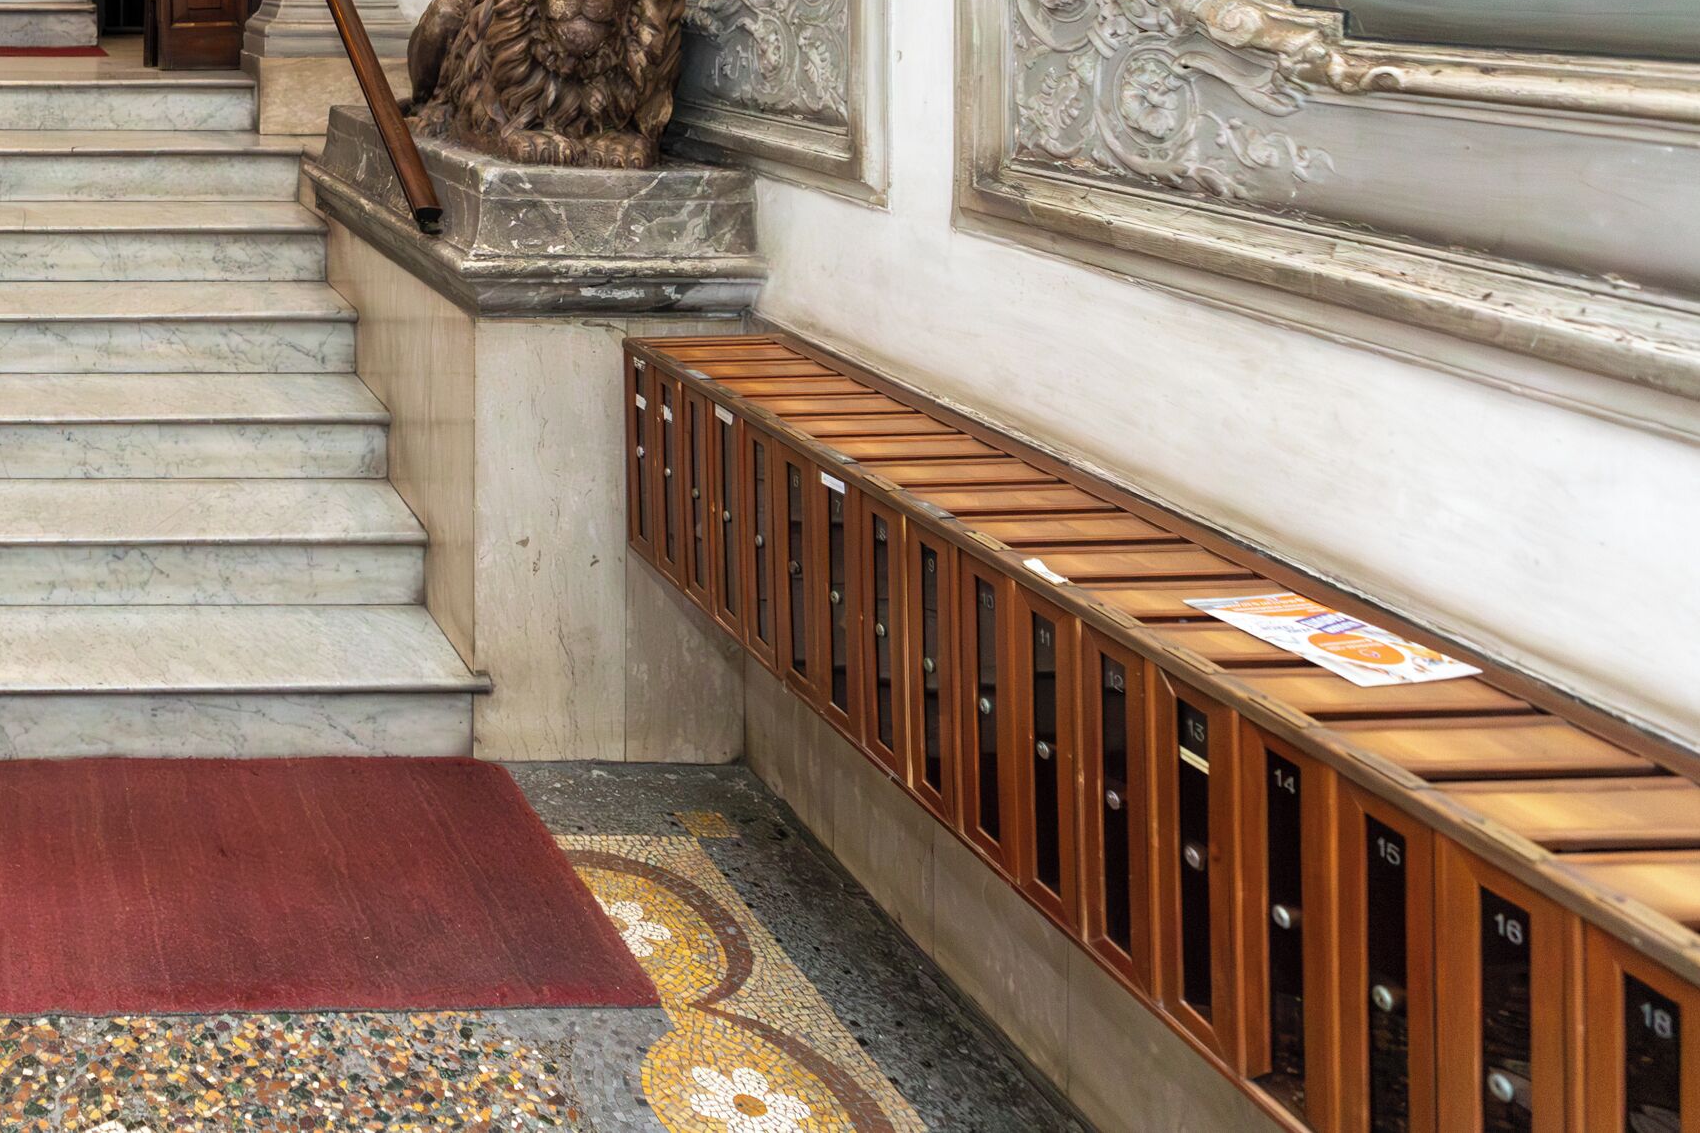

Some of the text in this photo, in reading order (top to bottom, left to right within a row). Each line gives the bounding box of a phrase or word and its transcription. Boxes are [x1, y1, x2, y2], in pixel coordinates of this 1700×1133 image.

[835, 500, 841, 513] 7
[879, 529, 887, 542] 8
[927, 558, 935, 573] 9
[981, 593, 994, 610] 10
[1039, 627, 1051, 648] 11
[1108, 670, 1125, 693] 12
[1187, 718, 1205, 742] 13
[1274, 768, 1296, 794] 14
[1377, 836, 1401, 866] 15
[1494, 912, 1523, 946] 16
[1640, 1002, 1673, 1040] 18
